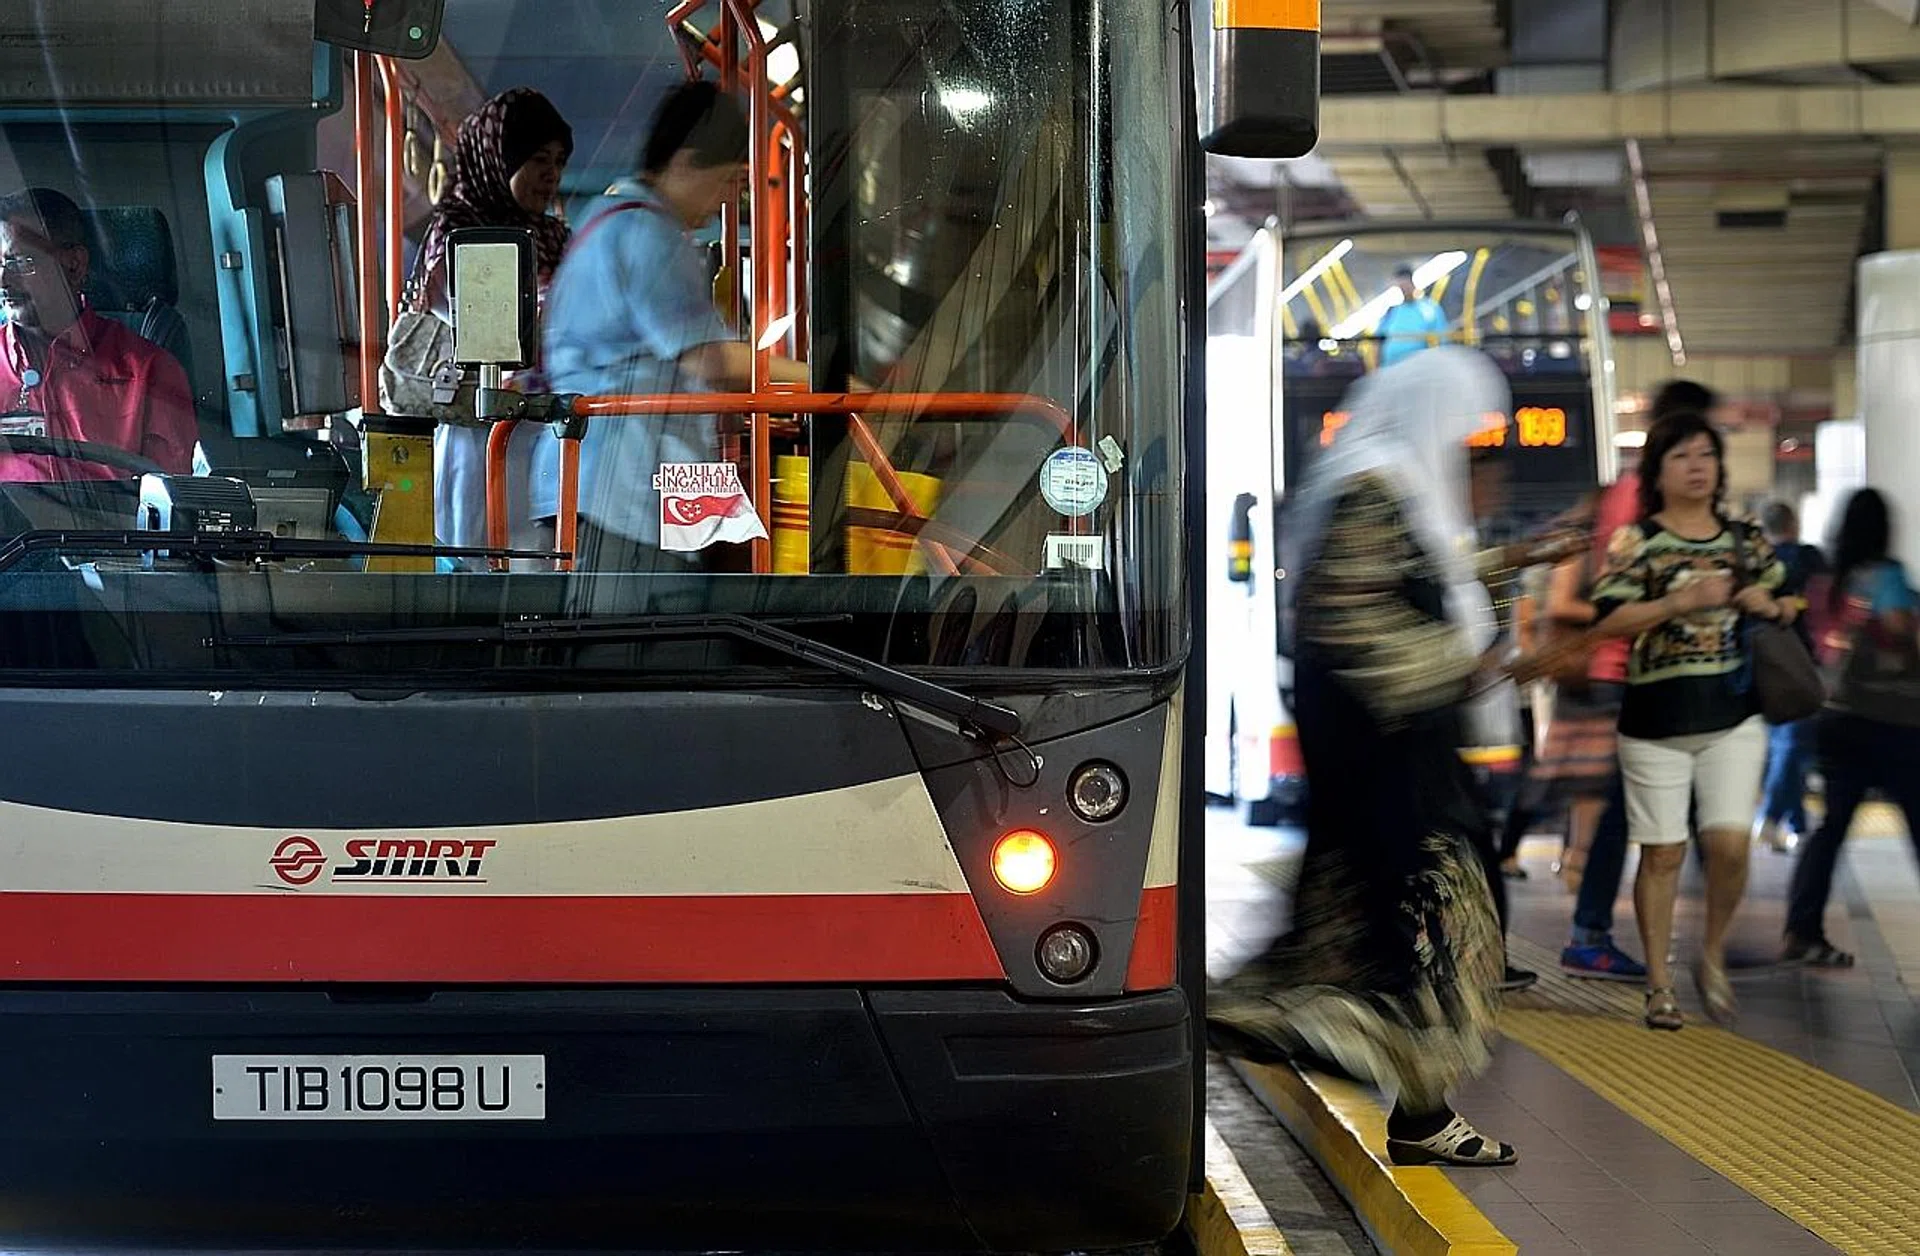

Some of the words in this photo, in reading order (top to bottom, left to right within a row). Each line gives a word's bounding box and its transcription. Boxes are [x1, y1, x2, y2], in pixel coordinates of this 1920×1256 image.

[663, 465, 735, 478] MAJULAH
[655, 476, 740, 488] SINGAPURA
[333, 839, 497, 876] SMRT
